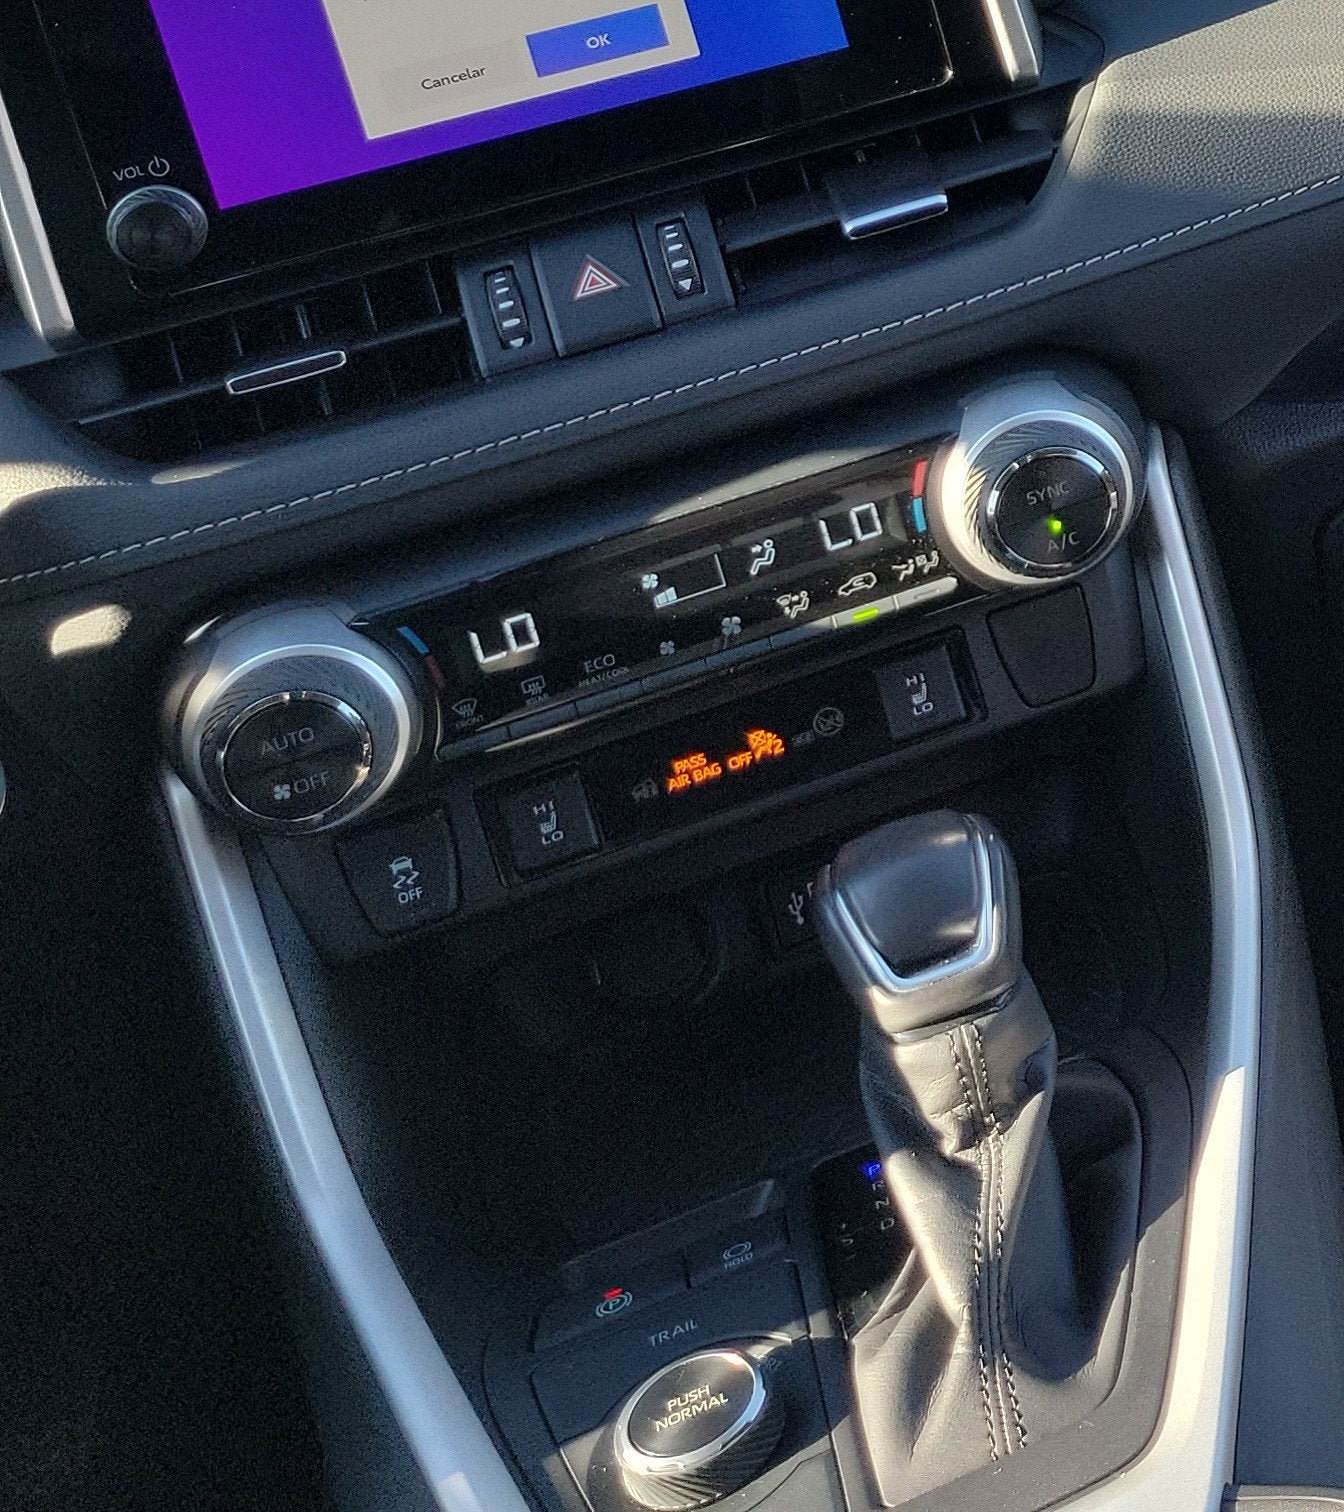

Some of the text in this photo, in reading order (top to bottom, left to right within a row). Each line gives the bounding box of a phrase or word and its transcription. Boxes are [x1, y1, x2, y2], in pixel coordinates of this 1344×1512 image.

[586, 33, 612, 50] OK
[421, 65, 487, 90] Cancelar
[112, 165, 145, 181] VOL
[1026, 481, 1070, 506] SYNC
[820, 502, 882, 551] LO
[1047, 531, 1079, 553] A/C
[467, 612, 540, 664] LO
[584, 654, 616, 673] ECO
[906, 672, 925, 687] HI
[913, 702, 933, 716] LO
[260, 727, 315, 756] AUTO
[669, 750, 753, 793] AIR BAG OFF
[674, 752, 707, 775] PASS
[293, 771, 331, 794] OFF
[533, 799, 555, 815] HI
[542, 829, 564, 845] LO
[398, 886, 423, 904] OFF
[875, 1196, 890, 1210] N
[881, 1217, 895, 1230] D
[724, 1253, 753, 1270] HOLD
[650, 1318, 699, 1347] TRAIL
[667, 1384, 711, 1412] PUSH
[654, 1391, 729, 1432] NORMAL
